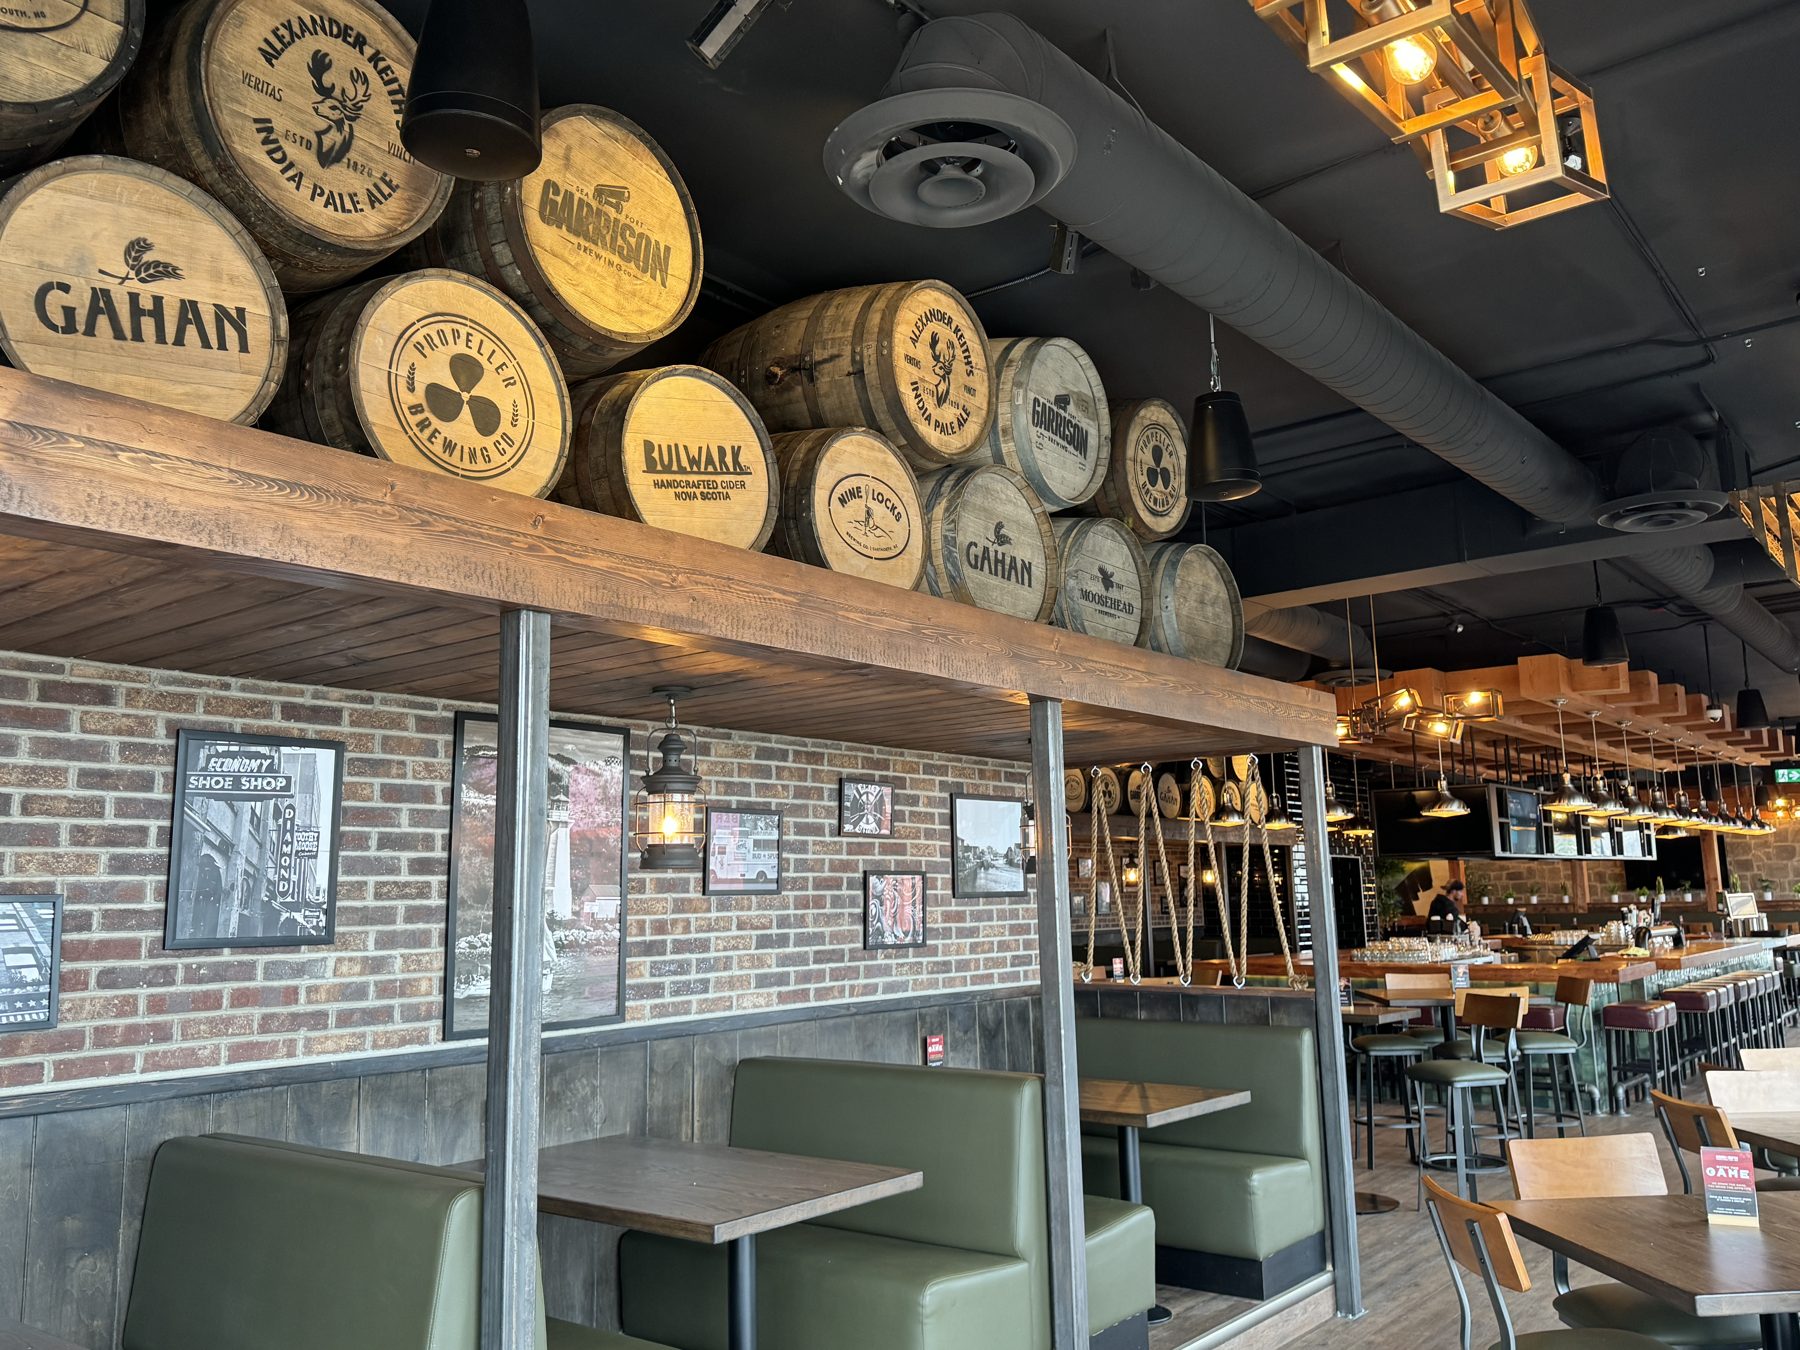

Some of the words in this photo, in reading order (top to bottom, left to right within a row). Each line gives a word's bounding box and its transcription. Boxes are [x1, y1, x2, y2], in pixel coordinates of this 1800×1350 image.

[241, 70, 283, 102] VERITAS
[257, 15, 367, 69] ALEXANDER
[367, 49, 407, 130] KEITH
[253, 118, 305, 192] INDIA
[310, 183, 364, 214] PALE
[366, 171, 400, 210] ALE
[284, 130, 313, 151] ESTD
[346, 158, 373, 178] 1820
[575, 185, 589, 199] SEA
[625, 214, 644, 229] PORT
[539, 178, 671, 289] GARRISON
[576, 242, 623, 272] BREWING
[34, 280, 251, 354] GAHAN
[413, 328, 517, 389] PROPELLER
[909, 308, 952, 349] ALEXANDER
[953, 324, 974, 377] KEITH'S
[910, 380, 932, 426] INDIA
[934, 419, 957, 436] PALE
[957, 404, 971, 431] ALE
[1032, 396, 1088, 460] GARRISON
[407, 403, 492, 464] BREWING
[493, 431, 515, 457] CO
[643, 439, 744, 472] BULWARK
[1140, 431, 1174, 459] PROPELLER
[653, 480, 718, 490] HANDCRAFTED
[720, 480, 746, 490] CIDER
[674, 491, 699, 501] NOVA
[700, 491, 731, 501] SCOTIA
[837, 486, 863, 508] NINE
[872, 488, 902, 522] LOCKS
[966, 541, 1032, 588] GAHAN
[1079, 587, 1134, 615] MOOSEHEAD
[188, 776, 233, 790] SHOE
[241, 777, 287, 791] SHOP
[208, 755, 273, 773] ECONOMY
[278, 808, 294, 892] DIAMOND
